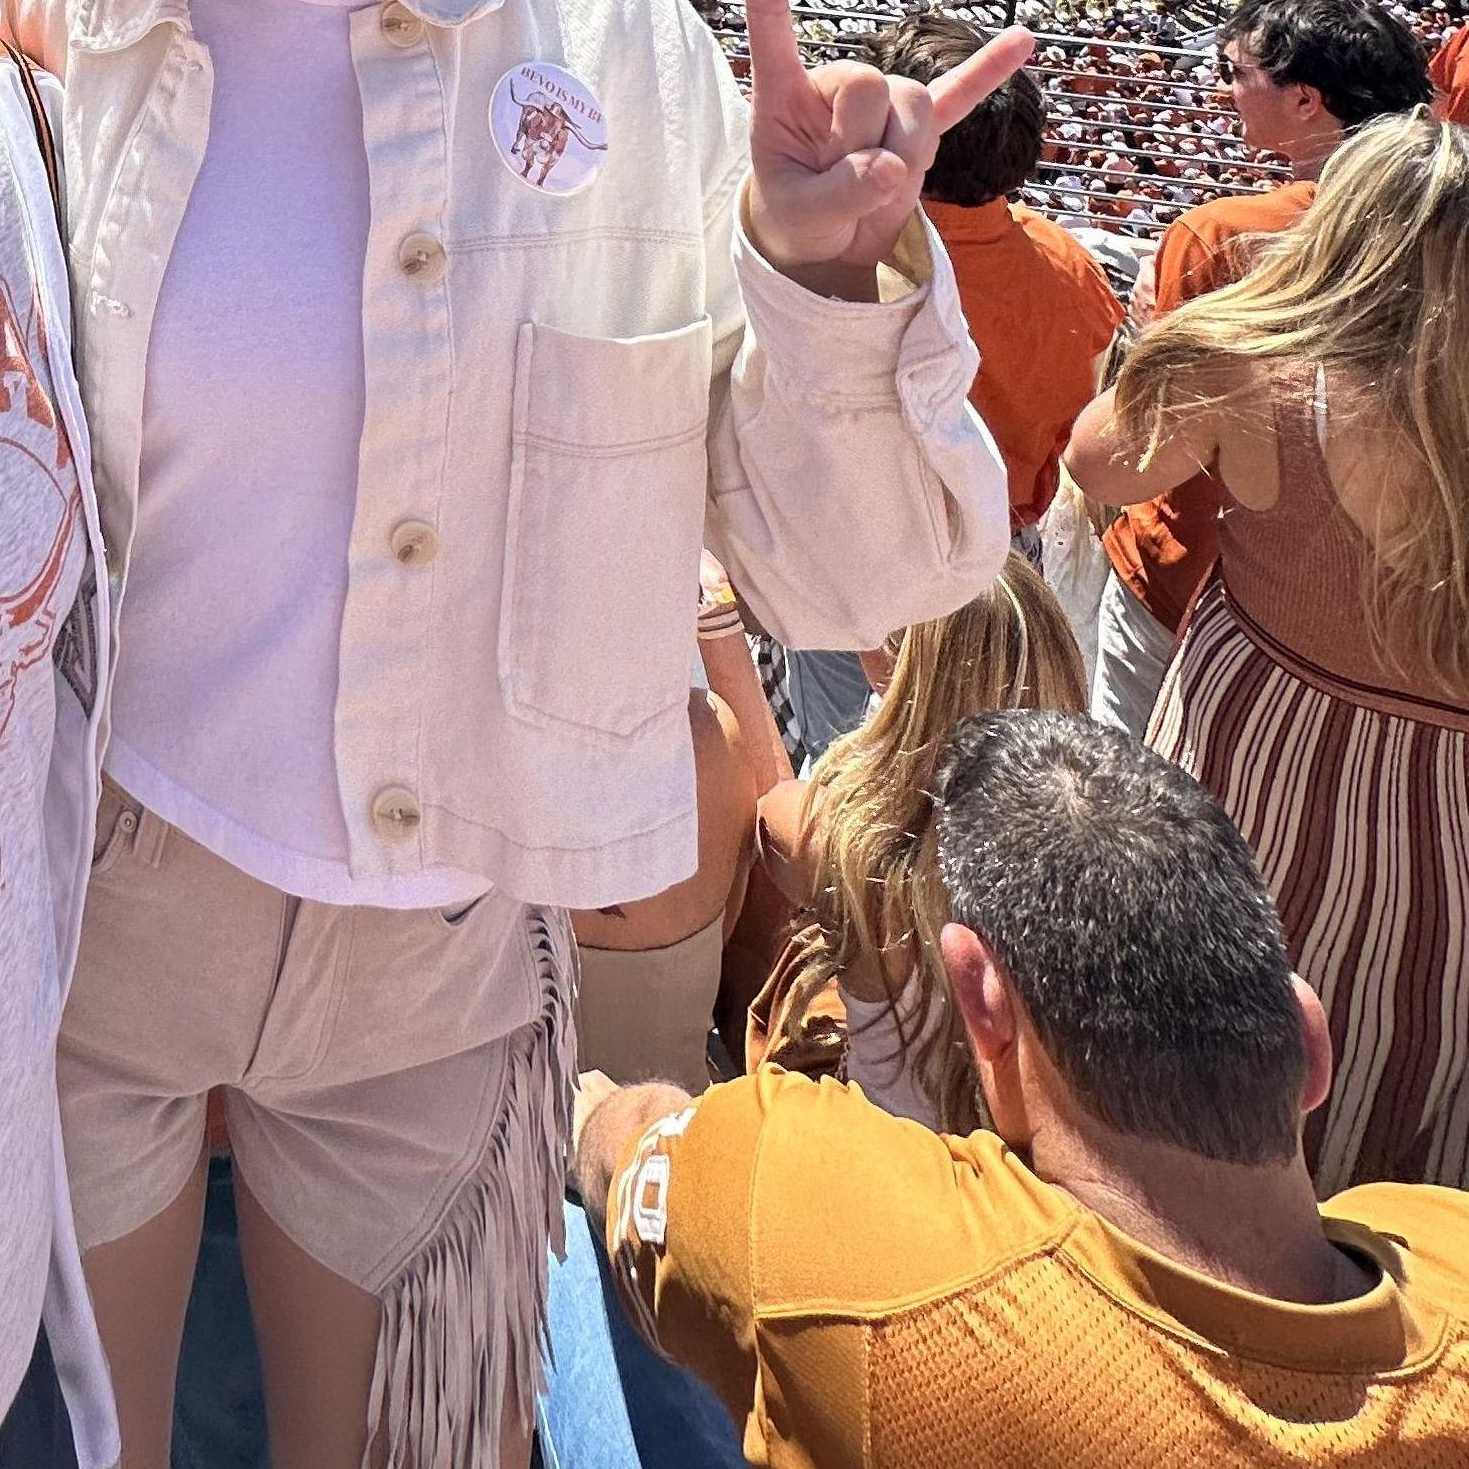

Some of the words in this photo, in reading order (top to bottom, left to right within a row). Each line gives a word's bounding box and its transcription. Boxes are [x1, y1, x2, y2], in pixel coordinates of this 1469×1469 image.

[520, 66, 556, 94] BEVO
[555, 86, 568, 103] IS
[569, 95, 587, 114] MY
